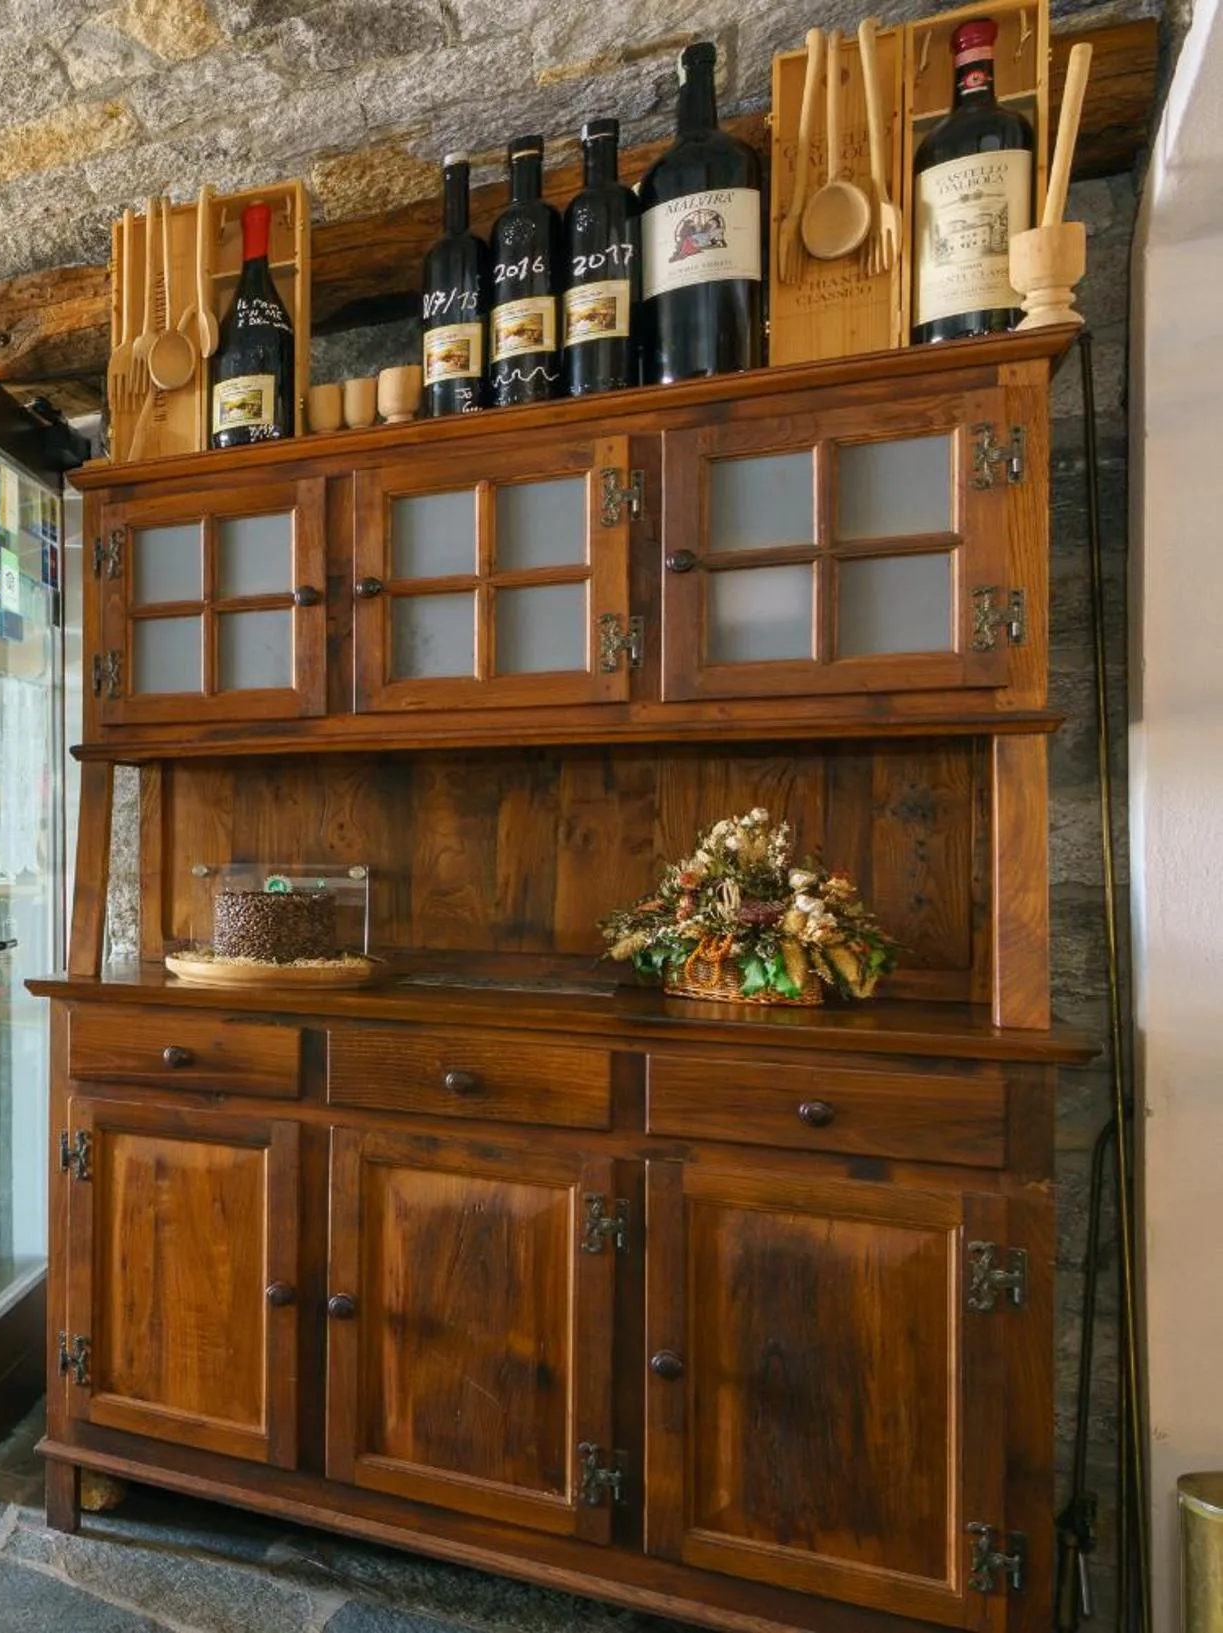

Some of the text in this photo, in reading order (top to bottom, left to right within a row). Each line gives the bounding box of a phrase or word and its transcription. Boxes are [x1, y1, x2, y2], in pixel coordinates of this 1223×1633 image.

[936, 162, 1009, 186] CASTELLO
[493, 255, 545, 284] 2016
[572, 244, 633, 277] 2017
[796, 284, 872, 306] CLASSICO
